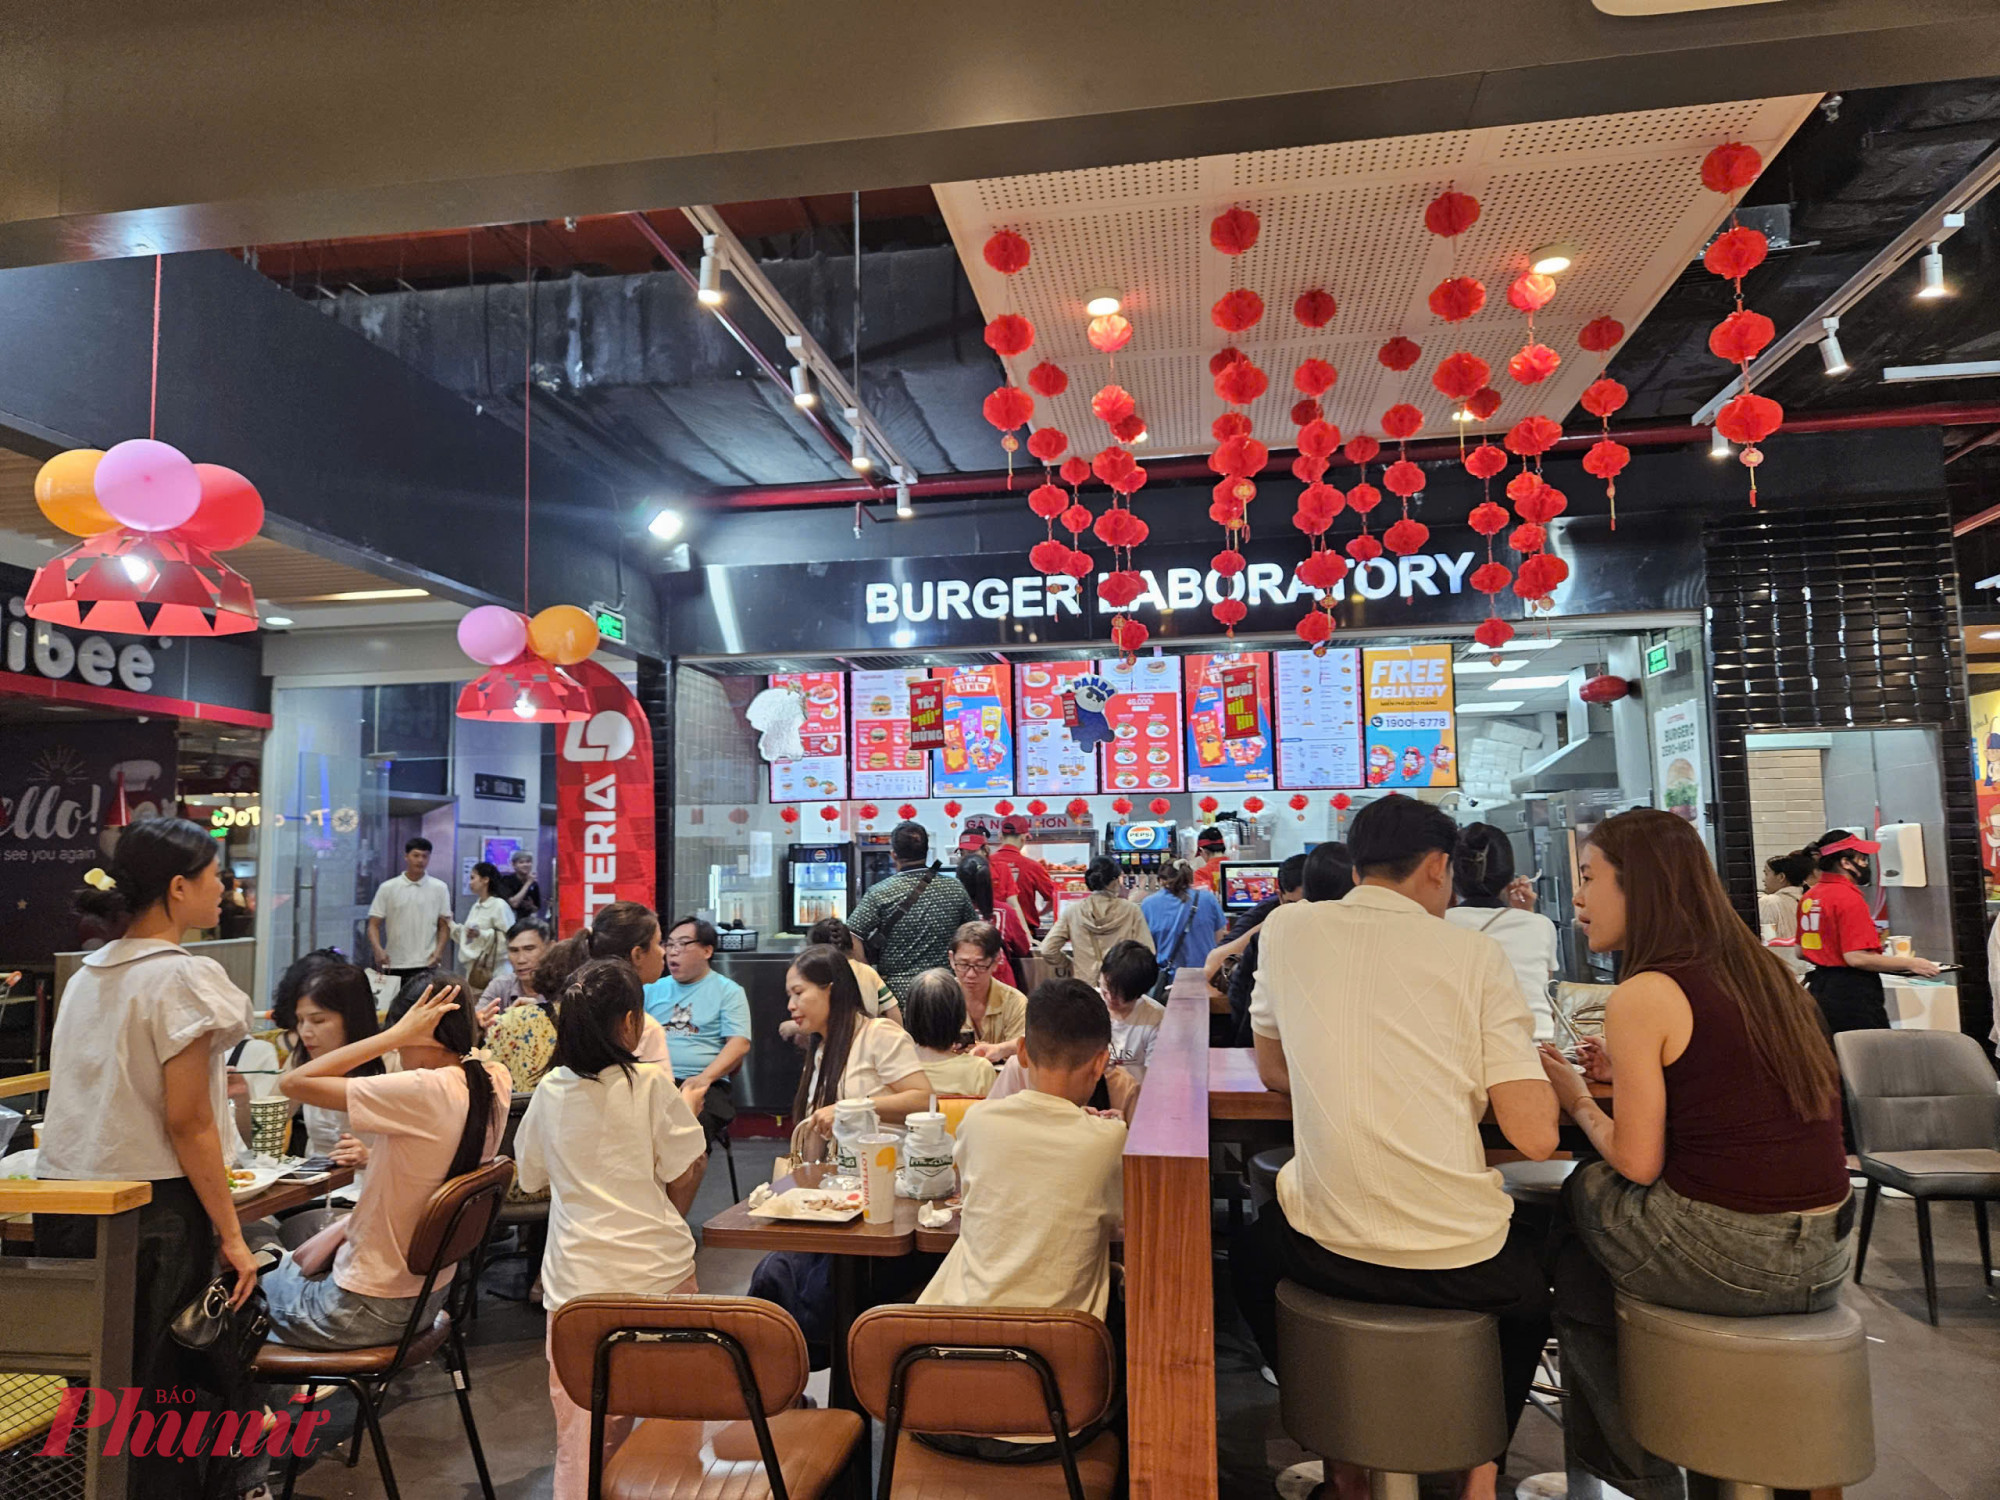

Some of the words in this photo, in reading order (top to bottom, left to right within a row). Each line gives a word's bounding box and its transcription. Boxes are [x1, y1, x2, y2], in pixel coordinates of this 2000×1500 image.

[866, 575, 1081, 623] BURGER
[0, 597, 154, 692] ibee
[1371, 659, 1447, 684] FREE
[1074, 677, 1115, 697] PANDA
[1370, 684, 1447, 699] DELIVERY
[1386, 718, 1446, 728] 1900-6778
[3, 850, 28, 861] see
[31, 850, 56, 864] you
[58, 849, 96, 864] again
[584, 774, 616, 928] TERIA
